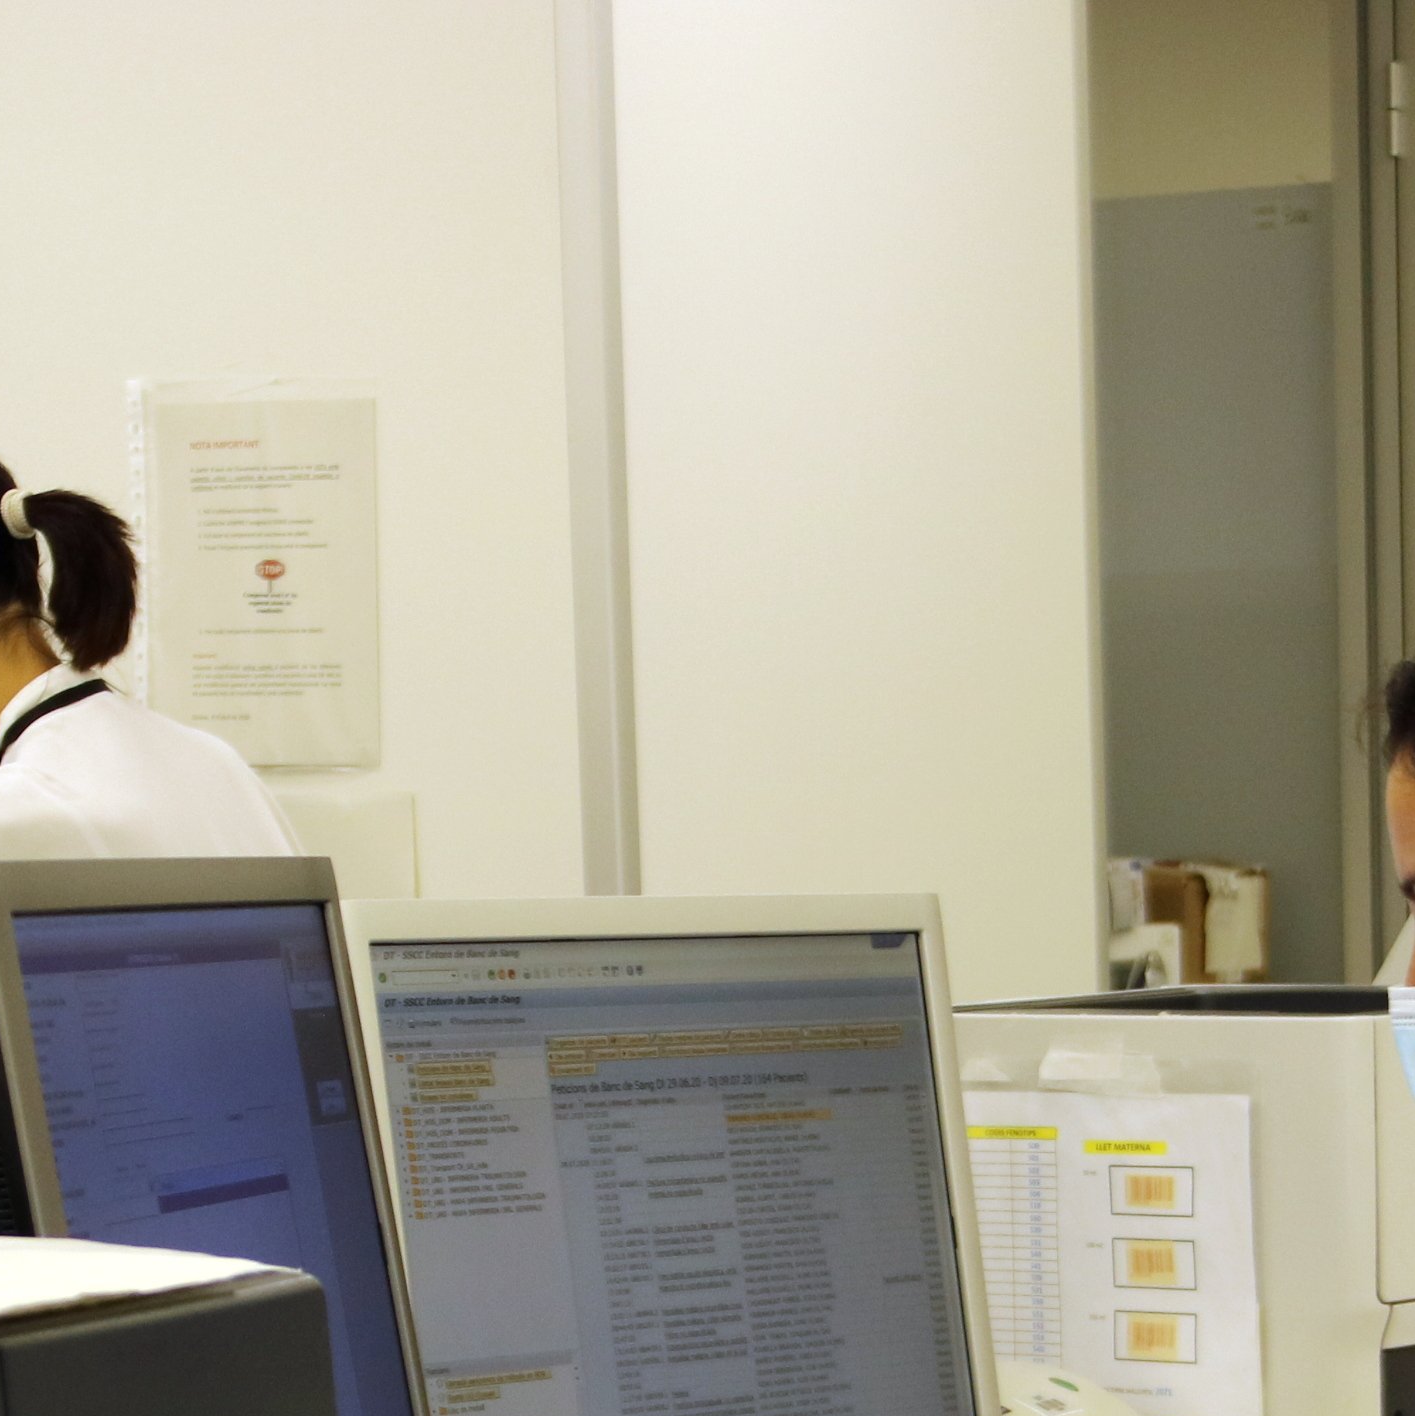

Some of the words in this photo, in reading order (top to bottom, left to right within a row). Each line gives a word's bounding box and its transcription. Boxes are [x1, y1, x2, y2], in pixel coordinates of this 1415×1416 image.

[589, 1082, 600, 1093] de
[622, 1081, 633, 1091] de
[634, 1080, 654, 1093] Sang
[1095, 1142, 1112, 1151] LLET
[1113, 1143, 1151, 1152] MATERNA
